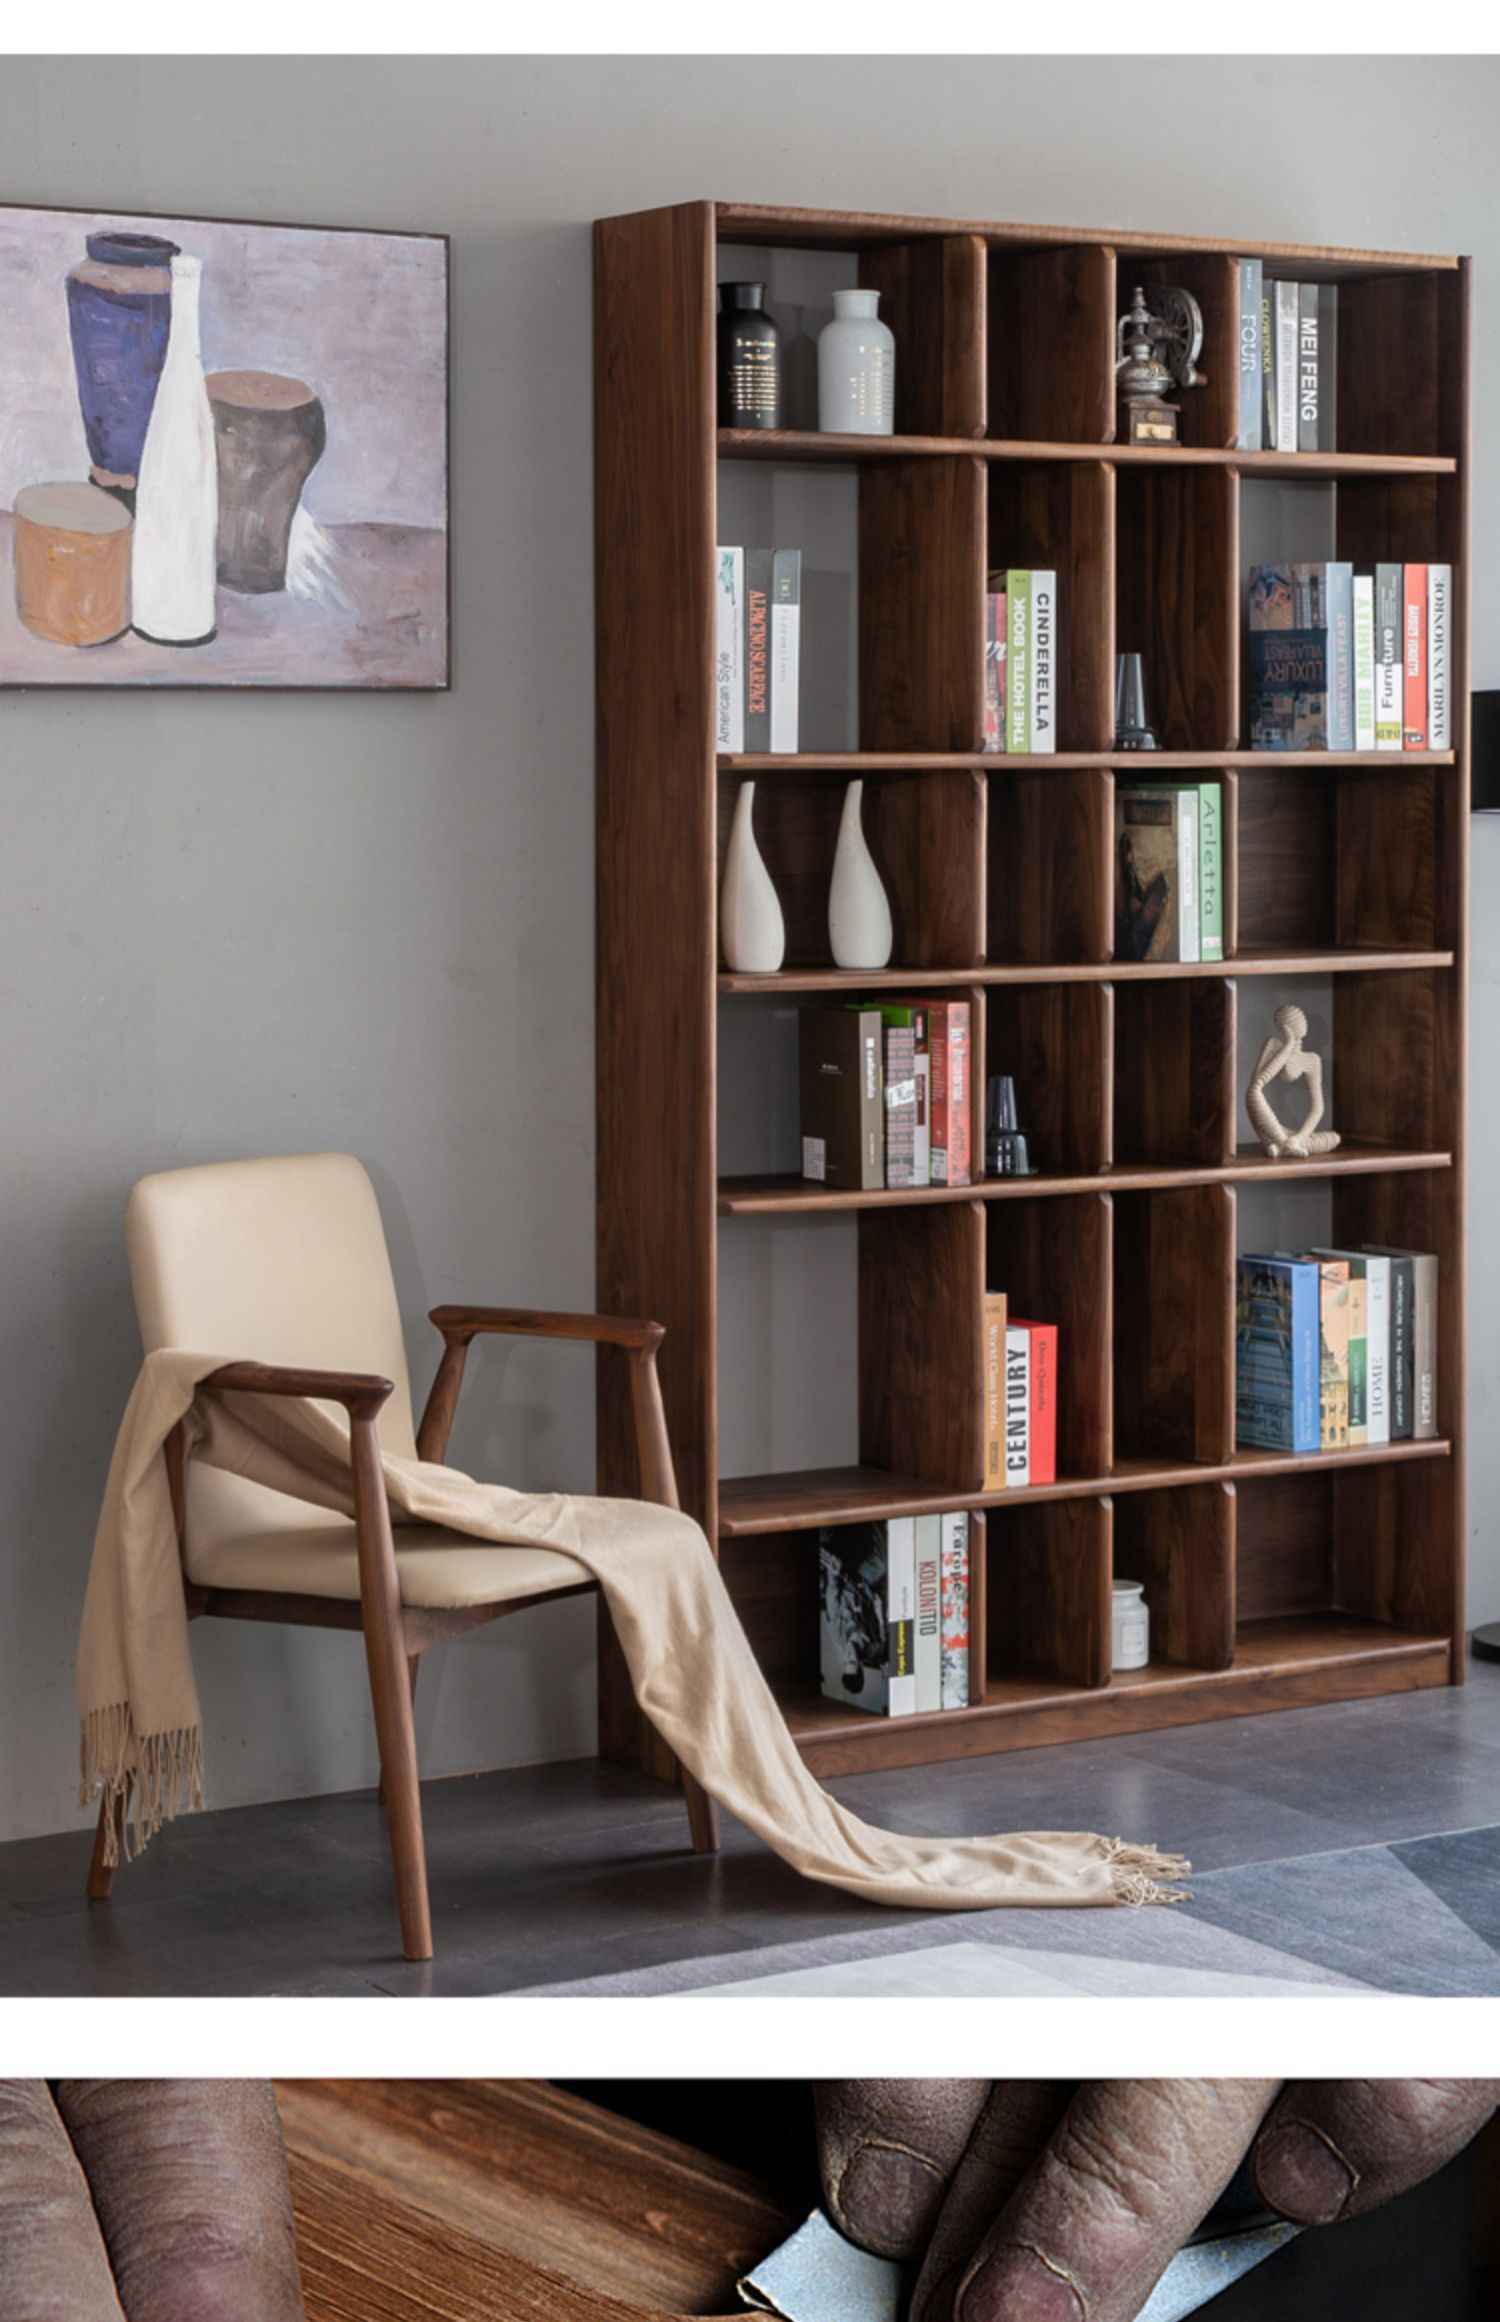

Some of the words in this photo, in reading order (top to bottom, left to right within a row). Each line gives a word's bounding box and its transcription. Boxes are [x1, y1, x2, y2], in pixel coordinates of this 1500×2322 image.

[1241, 314, 1257, 371] FOUR
[1301, 317, 1317, 355] MEI
[1301, 362, 1317, 421] FENG
[1013, 598, 1025, 646] BOOK
[1337, 612, 1347, 652] FEAST
[1357, 597, 1370, 677] MARLEY
[1434, 577, 1445, 653] MONROE
[718, 652, 731, 682] Style
[749, 652, 766, 713] SCARFACE
[1013, 652, 1025, 706] HOTEL
[1037, 593, 1049, 730] CINDERELLA
[1264, 661, 1323, 682] LUXURY
[1337, 655, 1348, 689] VILLA
[1381, 628, 1393, 709] Furniture
[718, 685, 729, 744] American
[1337, 691, 1349, 741] LUXURY
[1357, 688, 1371, 730] BOB
[1434, 657, 1445, 738] MARILYN
[1013, 711, 1025, 744] THE
[1204, 800, 1217, 916] Arletta
[989, 1325, 999, 1360] World
[1396, 1328, 1402, 1336] IN
[1007, 1349, 1027, 1471] CENTURY
[1371, 1357, 1383, 1416] HOME
[950, 1524, 965, 1593] Europe
[919, 1561, 937, 1636] KOLONITID
